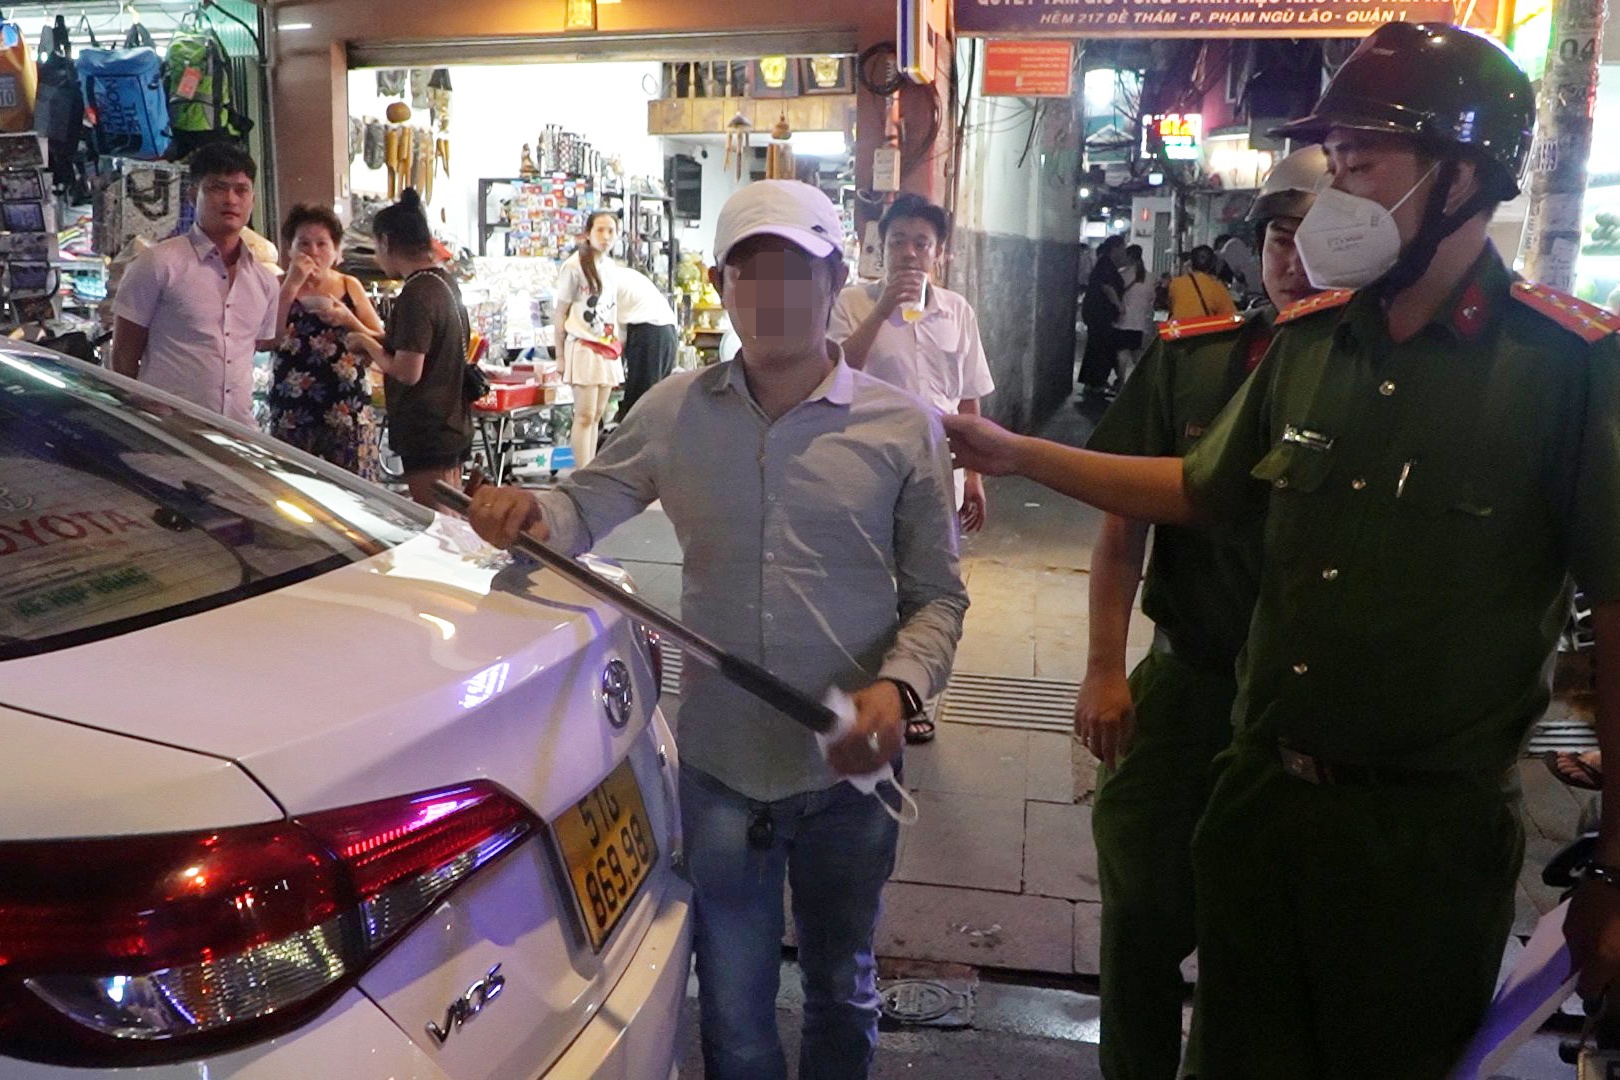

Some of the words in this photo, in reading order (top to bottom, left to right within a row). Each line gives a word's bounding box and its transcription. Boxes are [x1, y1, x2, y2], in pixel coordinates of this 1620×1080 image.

[1077, 12, 1103, 24] 217
[1134, 10, 1177, 23] THÁM
[1189, 12, 1204, 23] P.
[1209, 11, 1256, 26] PHẠM
[1298, 8, 1333, 23] LÃO
[1399, 10, 1407, 22] 1
